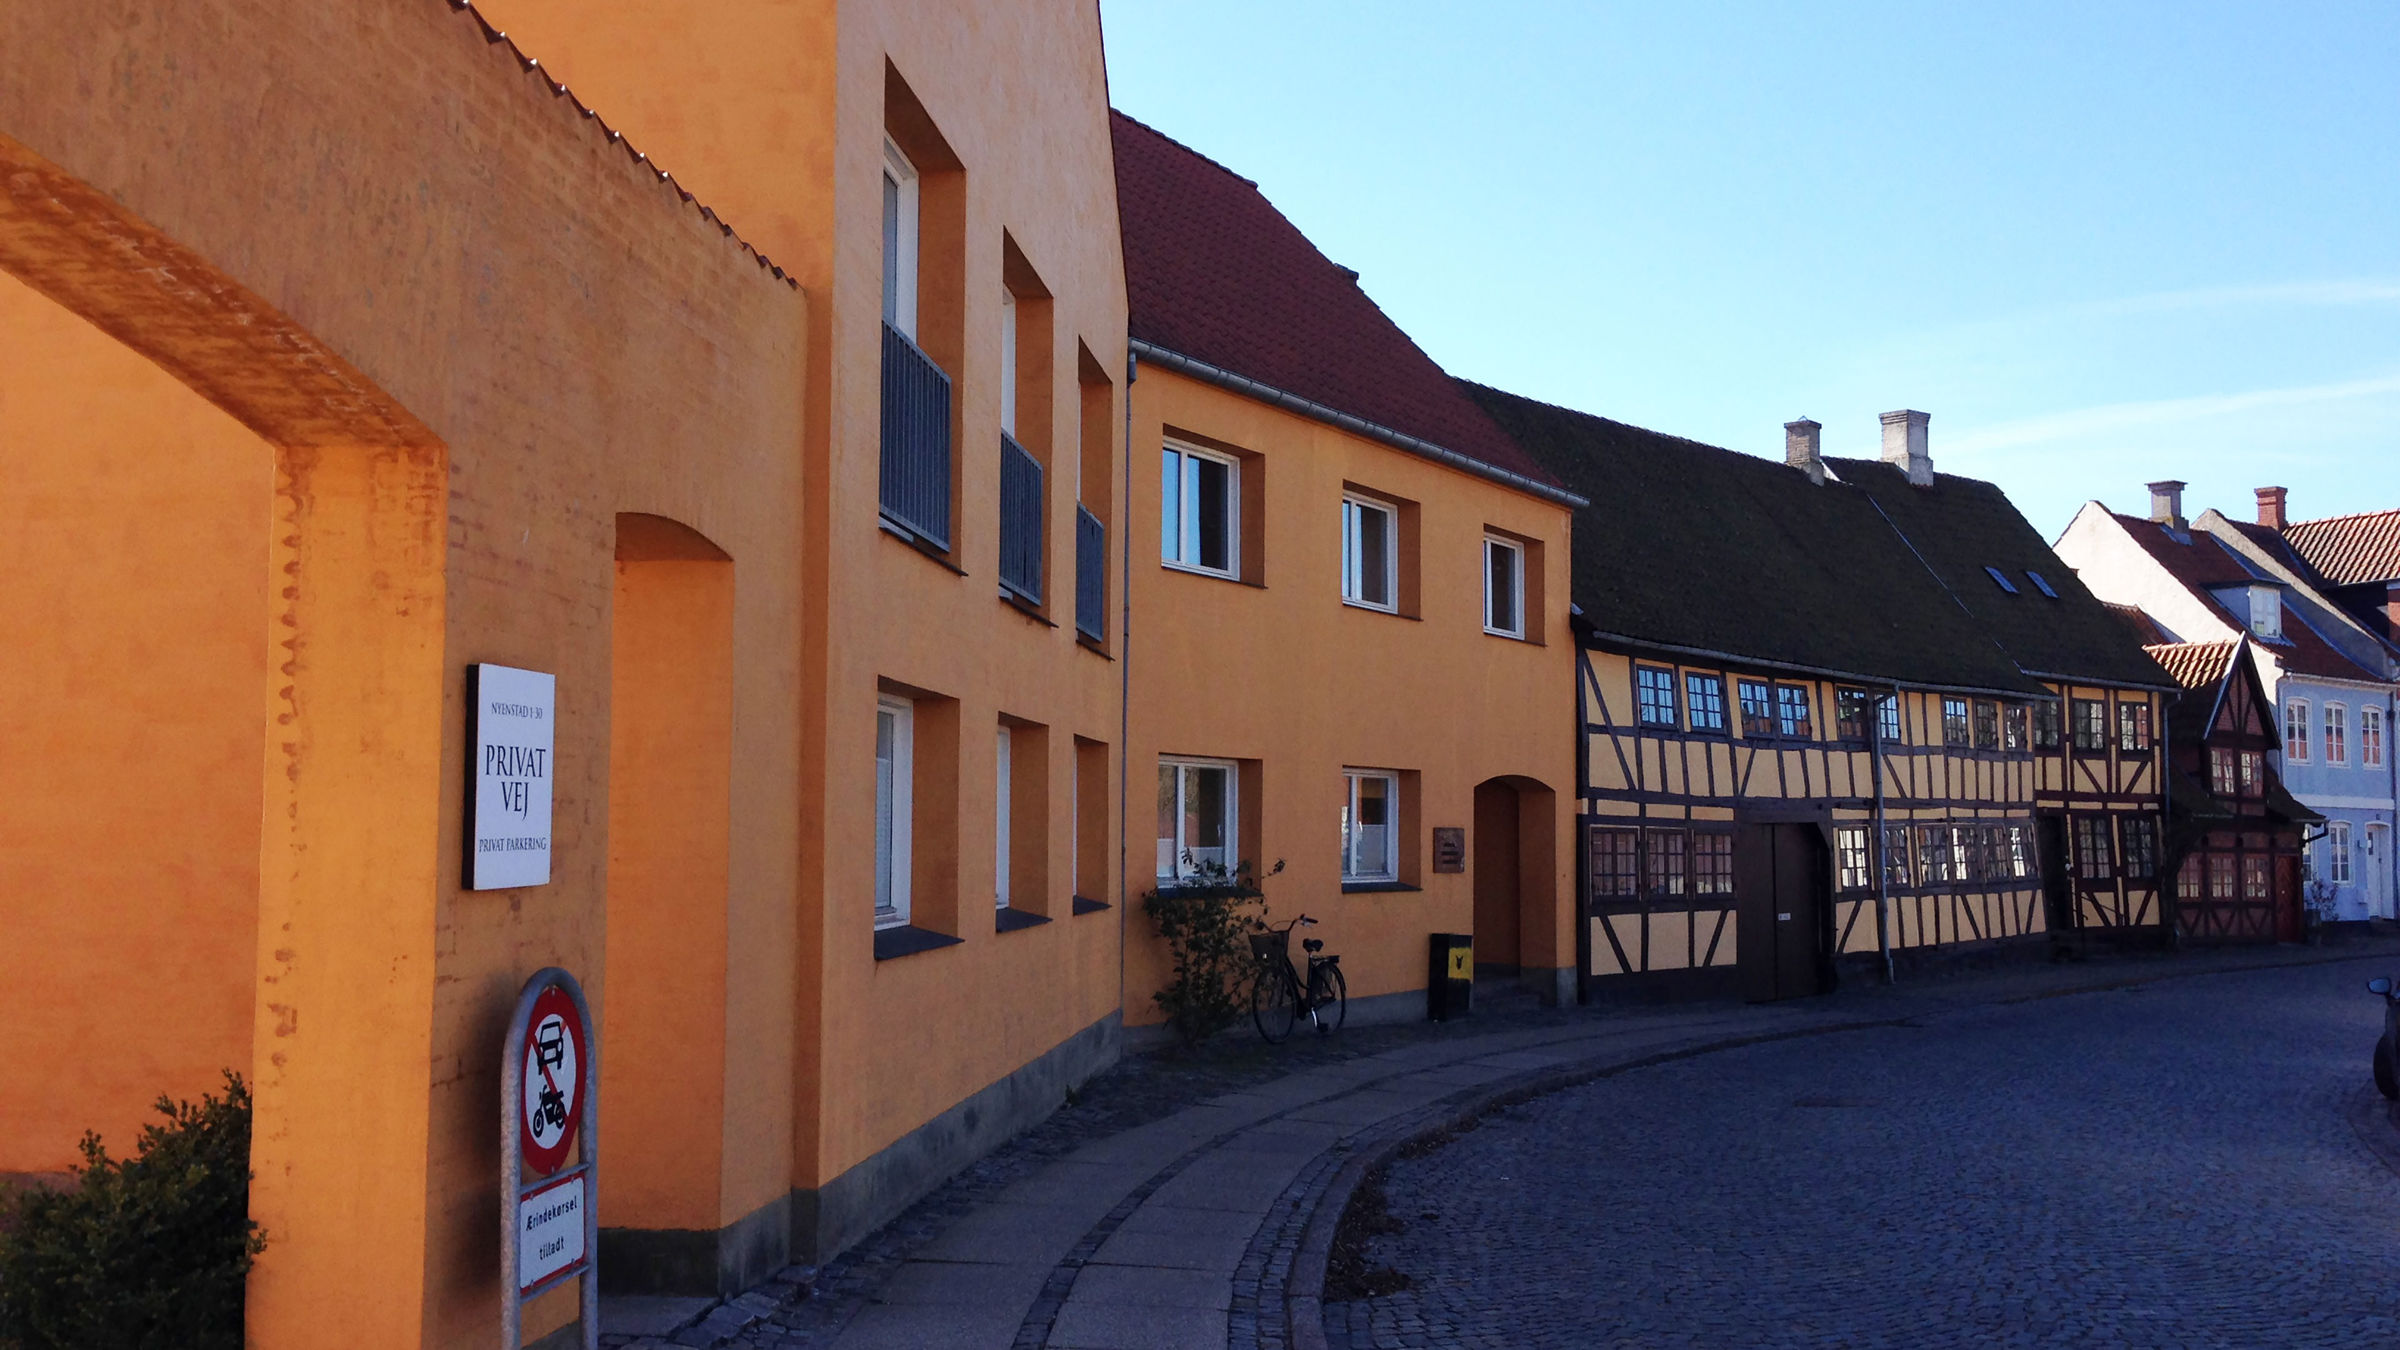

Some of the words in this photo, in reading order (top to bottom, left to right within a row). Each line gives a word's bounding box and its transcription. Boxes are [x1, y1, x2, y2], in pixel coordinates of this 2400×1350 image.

[491, 702, 528, 718] NYENSTAD
[485, 744, 546, 777] PRIVAT
[501, 781, 529, 821] VEJ
[479, 838, 504, 852] PRIVAT
[506, 837, 546, 851] PARKERING
[526, 1195, 577, 1231] Ærindekørsel
[539, 1236, 564, 1260] tilladt
